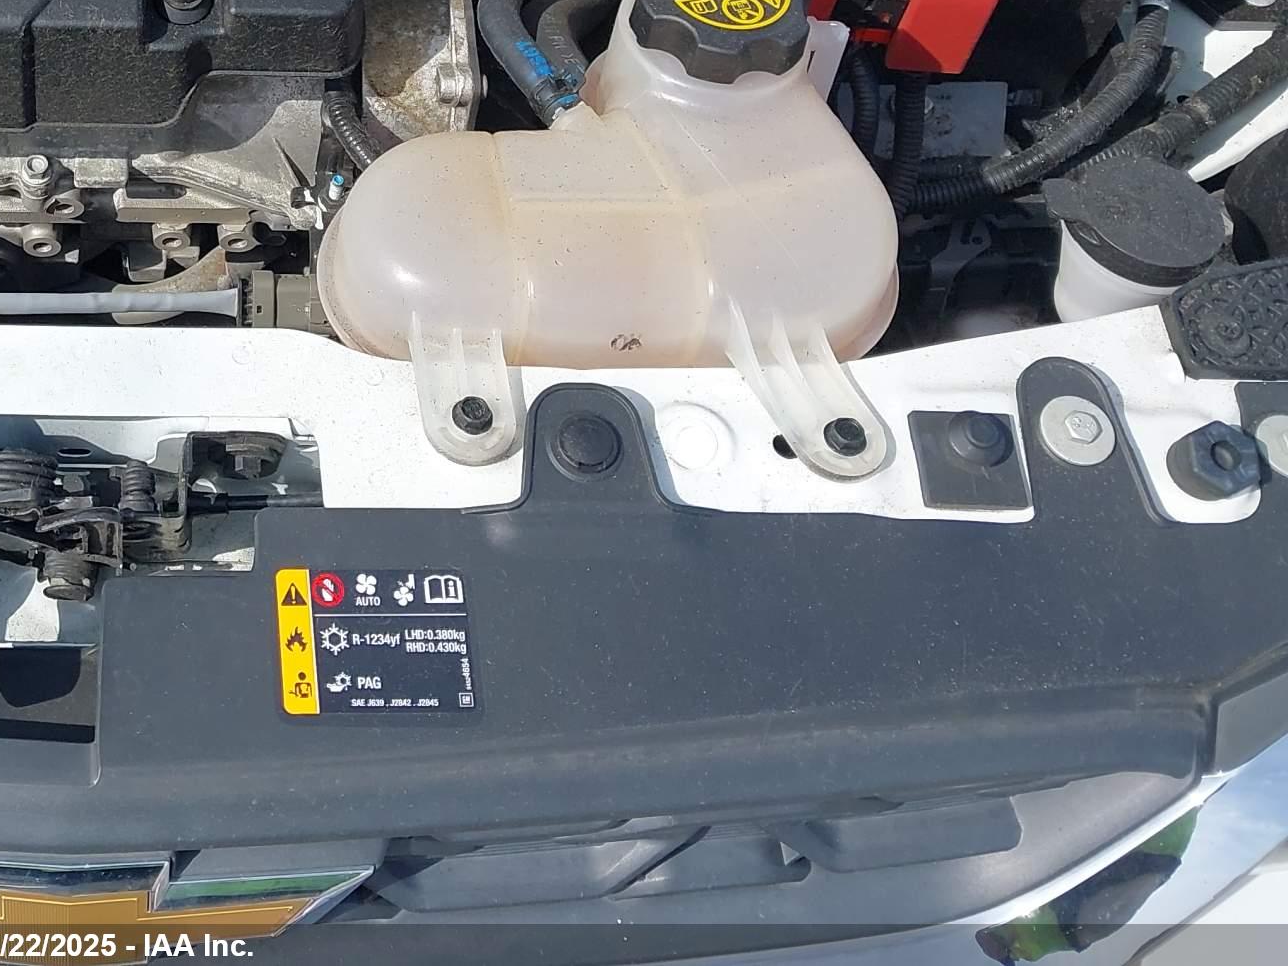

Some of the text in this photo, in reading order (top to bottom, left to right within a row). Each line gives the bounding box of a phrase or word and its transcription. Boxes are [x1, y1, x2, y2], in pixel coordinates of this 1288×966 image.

[355, 595, 381, 607] AUTO
[352, 629, 465, 647] R-1234yf LHD:0.380kg
[406, 642, 467, 654] RHD:0.430kg
[357, 677, 382, 690] PAG
